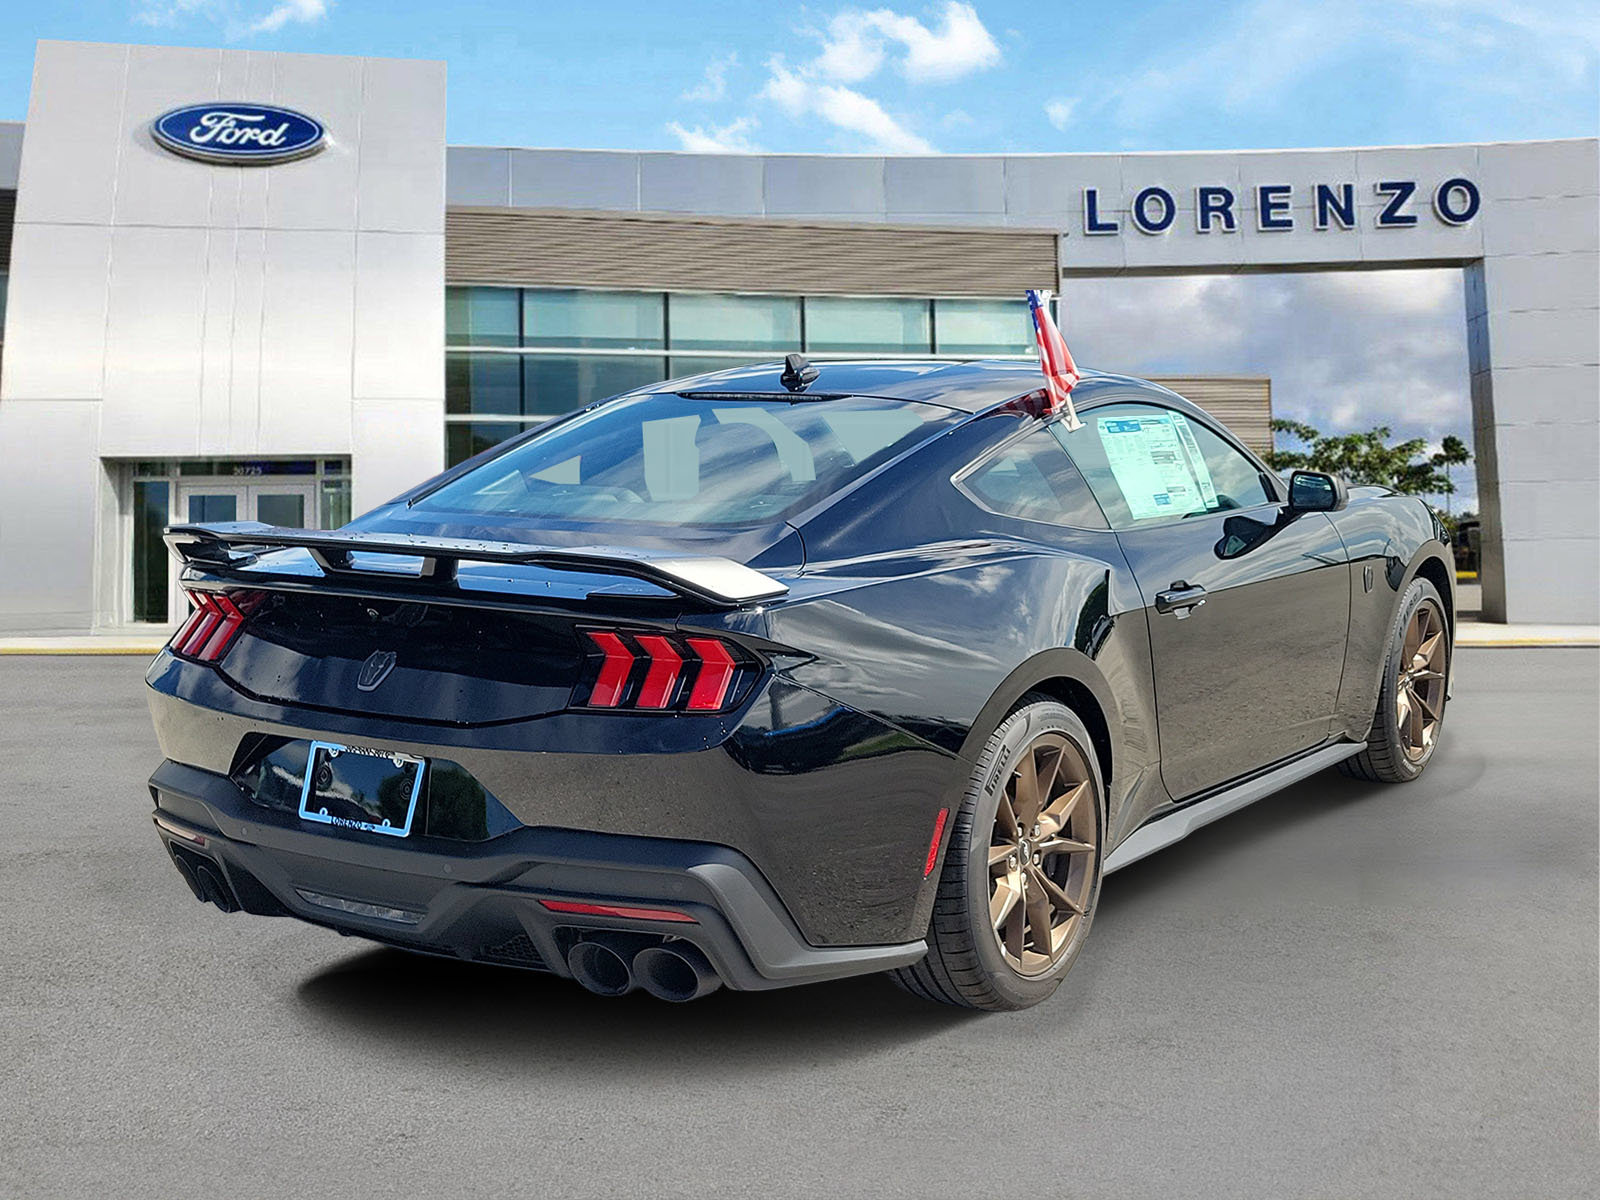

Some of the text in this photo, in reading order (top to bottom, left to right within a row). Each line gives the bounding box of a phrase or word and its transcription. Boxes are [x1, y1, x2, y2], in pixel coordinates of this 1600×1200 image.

[190, 112, 289, 147] Ford
[1083, 177, 1481, 235] LORENZO
[984, 744, 1011, 797] PIRELLI
[331, 816, 363, 830] LORENZO
